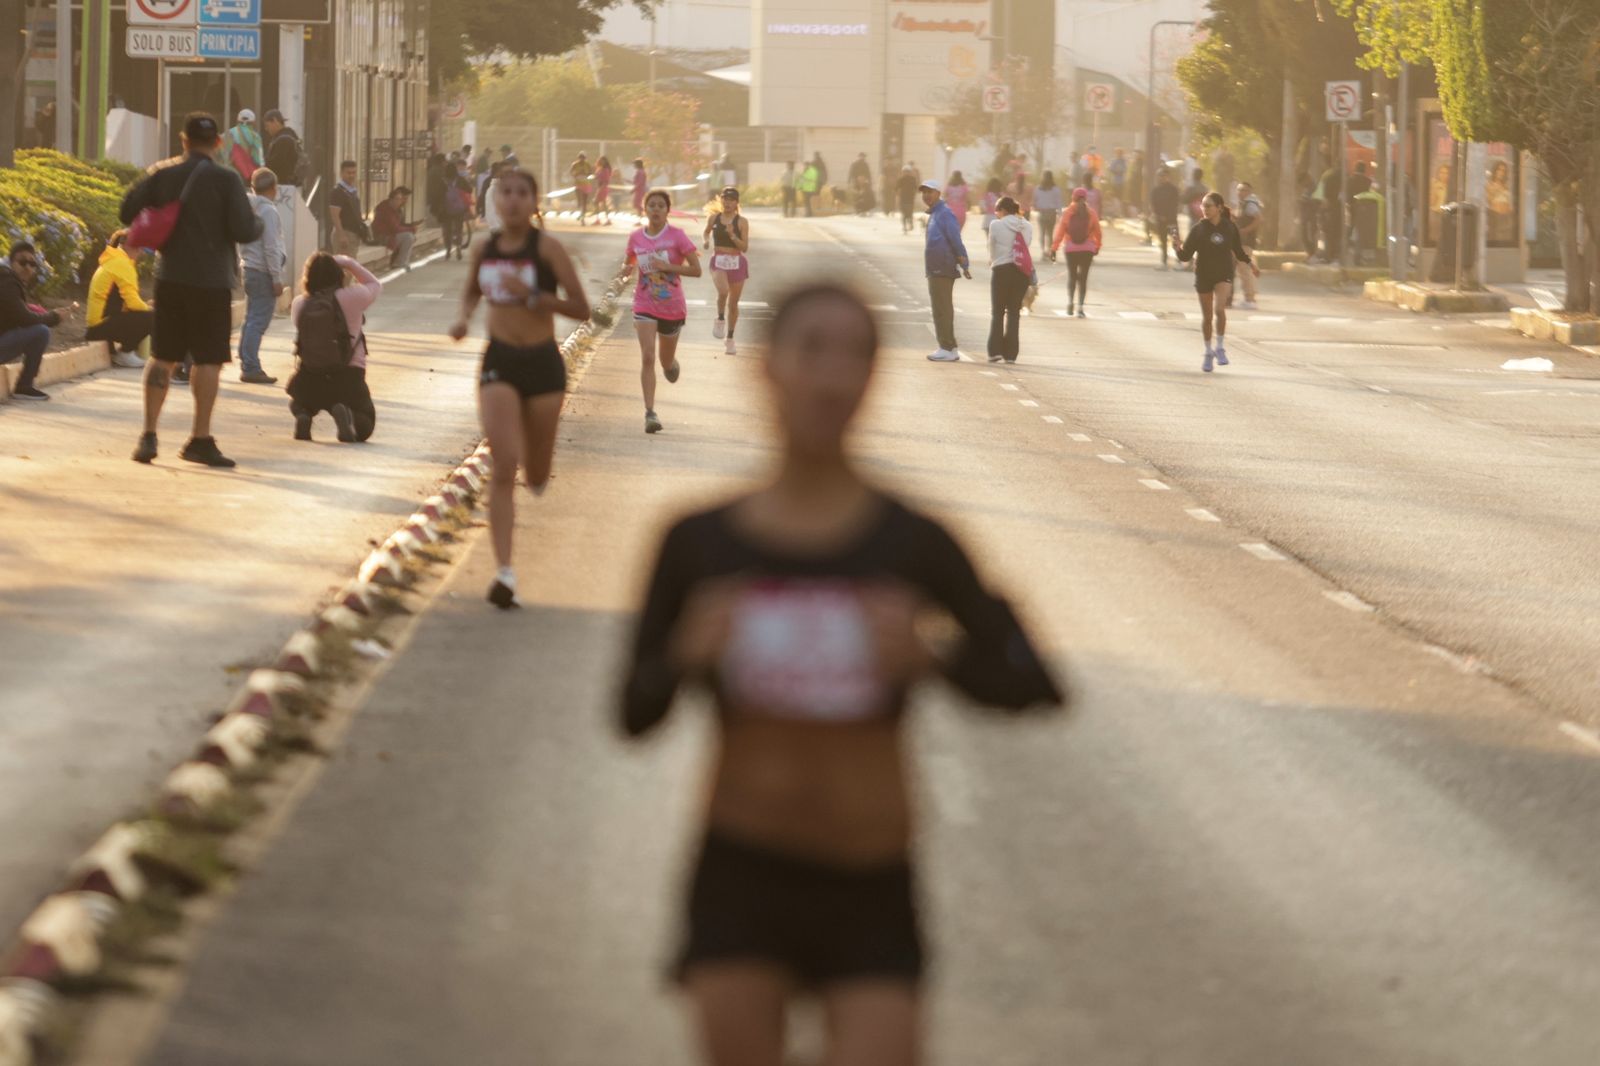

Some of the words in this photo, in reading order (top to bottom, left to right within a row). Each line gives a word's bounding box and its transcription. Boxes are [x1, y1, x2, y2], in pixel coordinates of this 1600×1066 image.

[132, 33, 164, 51] SOLO
[169, 35, 192, 52] BUS
[201, 33, 256, 53] PRINCIPIA
